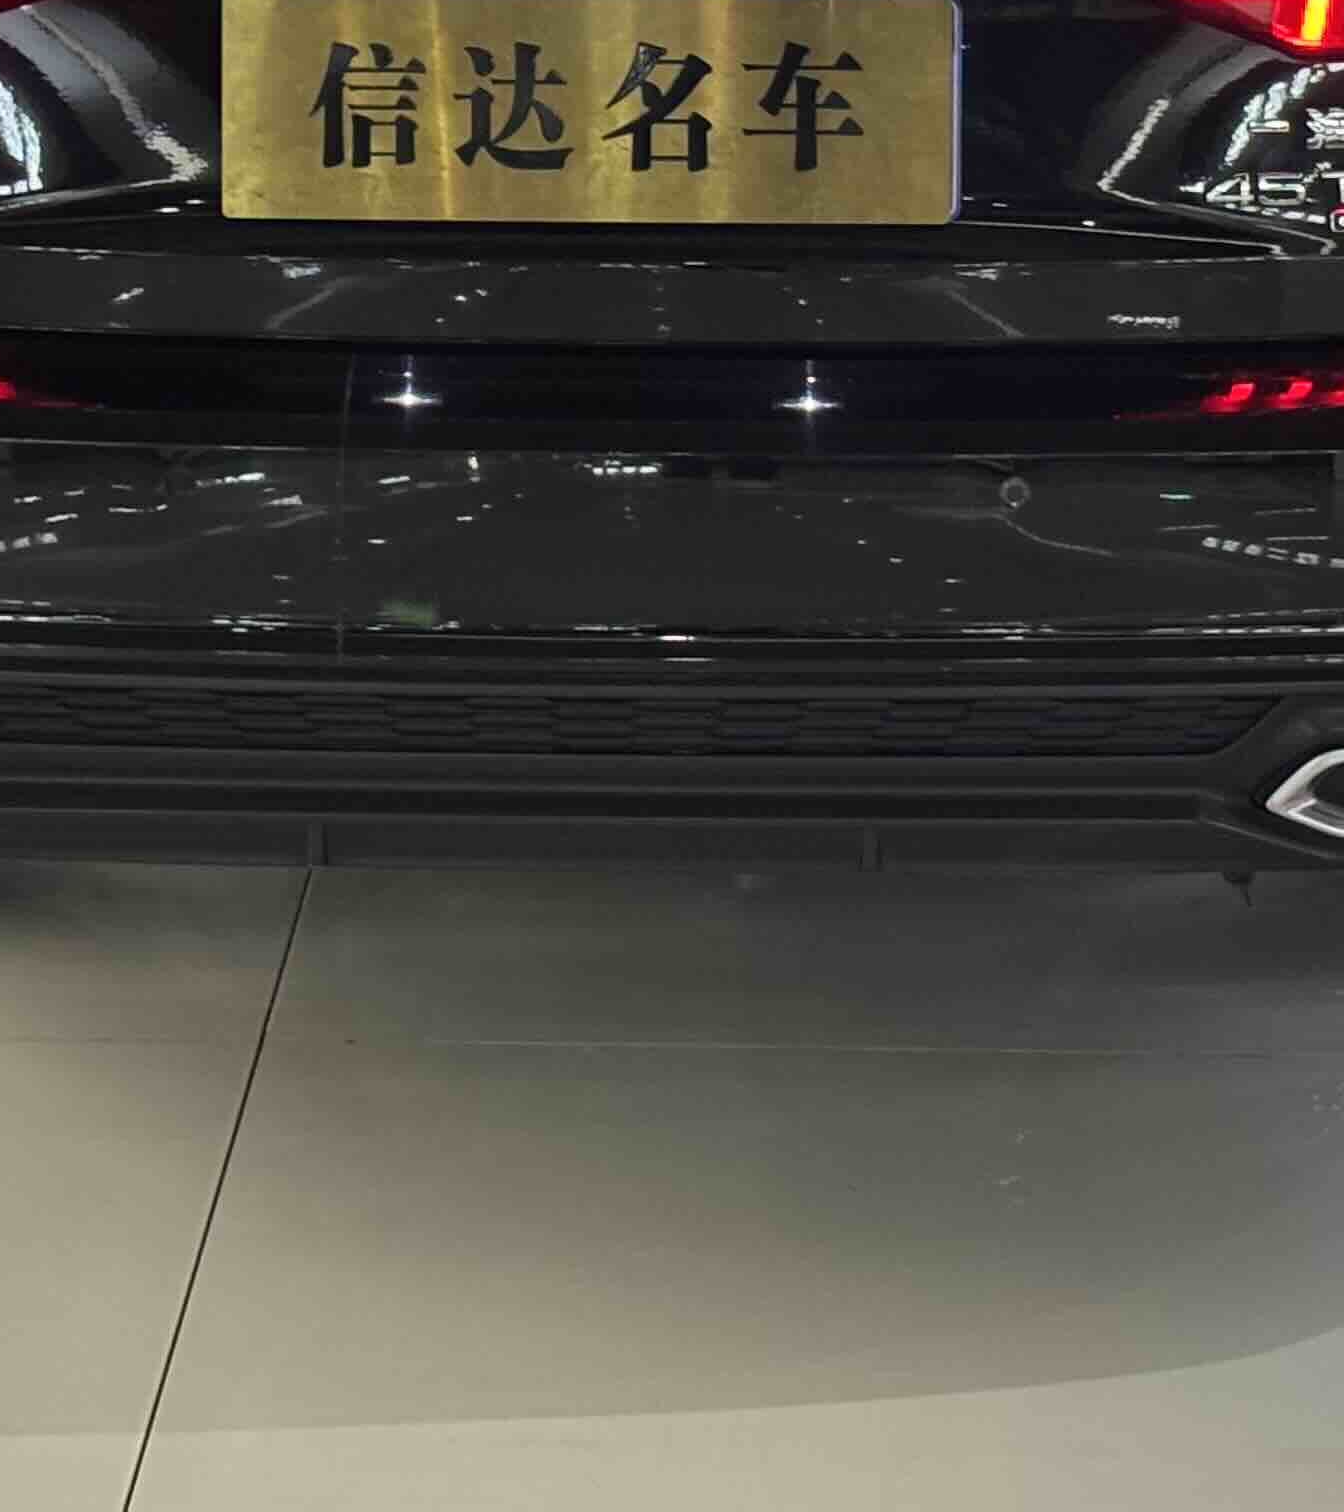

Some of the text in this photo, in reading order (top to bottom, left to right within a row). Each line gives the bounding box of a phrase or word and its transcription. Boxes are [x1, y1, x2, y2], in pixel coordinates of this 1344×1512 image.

[311, 41, 864, 171] 信达名车
[1206, 172, 1307, 206] 45
